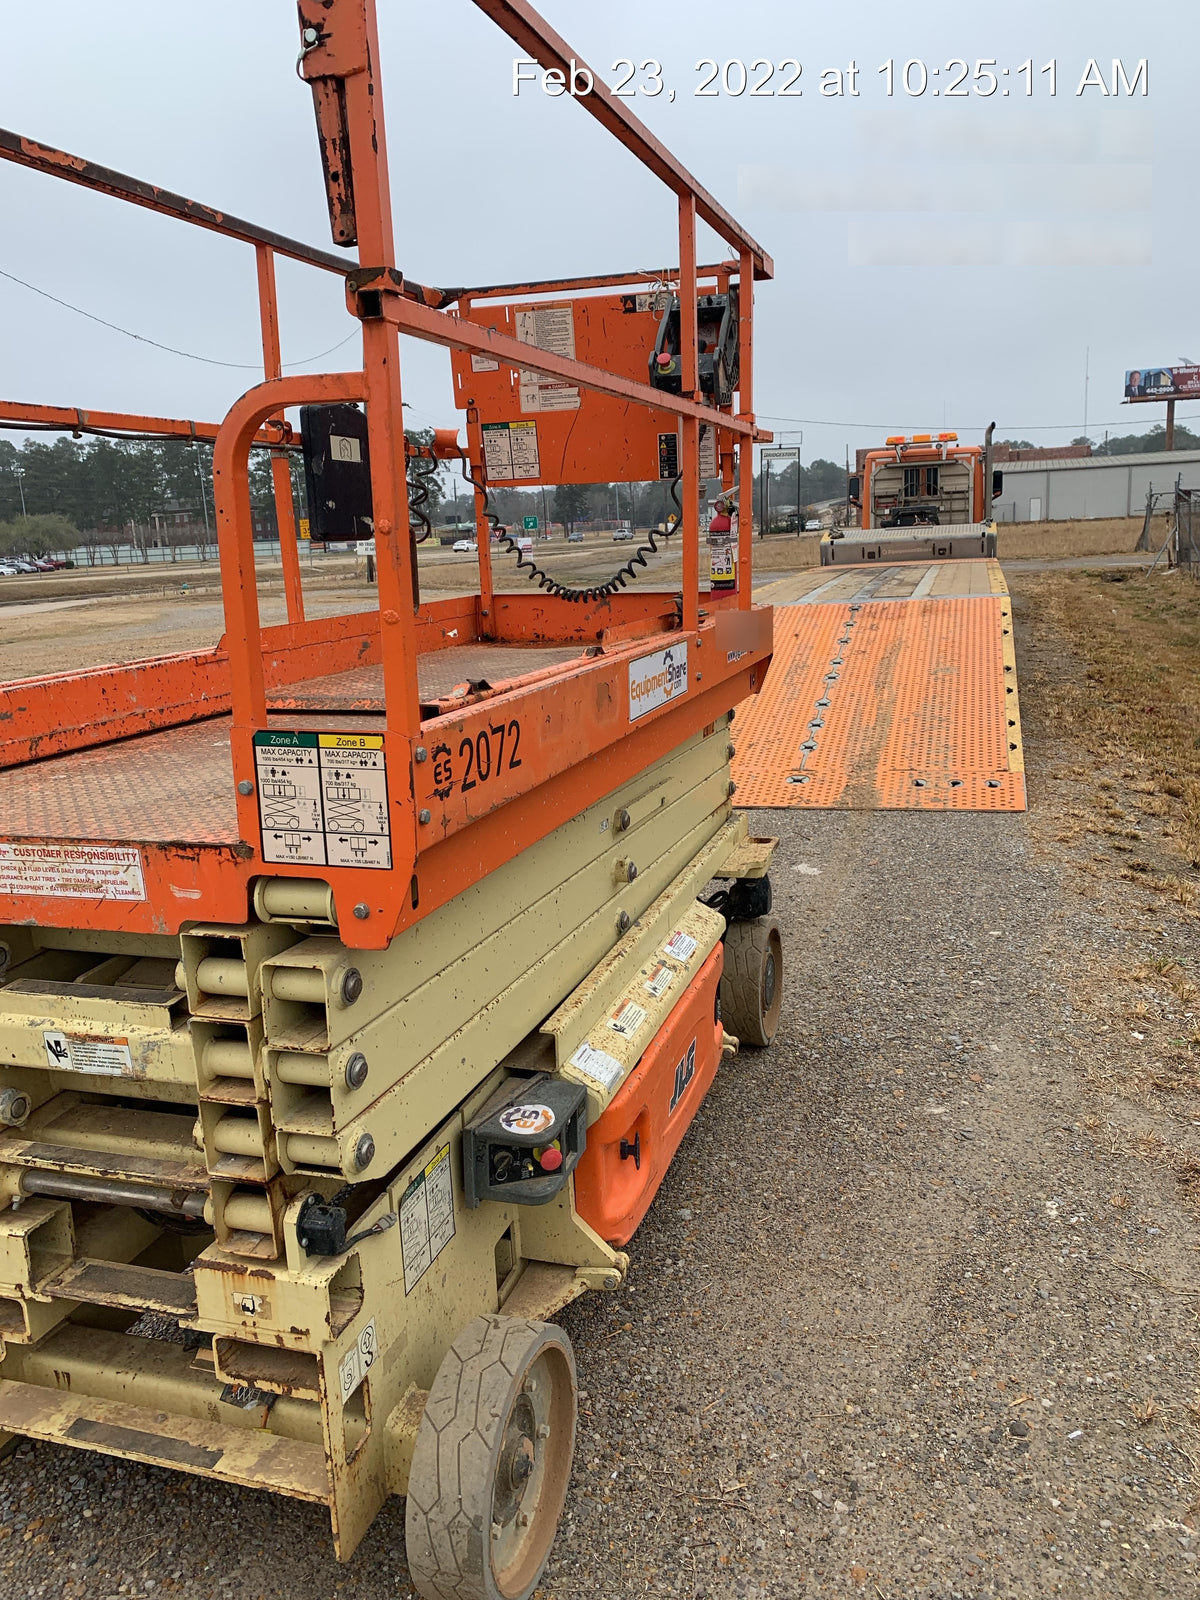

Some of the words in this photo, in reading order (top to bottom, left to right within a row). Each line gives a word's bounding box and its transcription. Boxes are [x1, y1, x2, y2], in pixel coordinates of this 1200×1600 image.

[270, 735, 291, 745] Zone
[292, 736, 299, 745] A
[336, 737, 357, 747] Zone
[359, 738, 366, 747] B
[260, 748, 277, 756] MAX
[277, 748, 312, 757] CAPACITY
[324, 750, 341, 758] MAX
[341, 751, 378, 760] CAPACITY
[458, 719, 522, 793] 2072
[433, 758, 452, 785] ES
[13, 847, 62, 858] CUSTOMER
[63, 850, 138, 862] RESPONSIBILITY
[61, 867, 75, 875] DAILY
[668, 1036, 696, 1118] JLG
